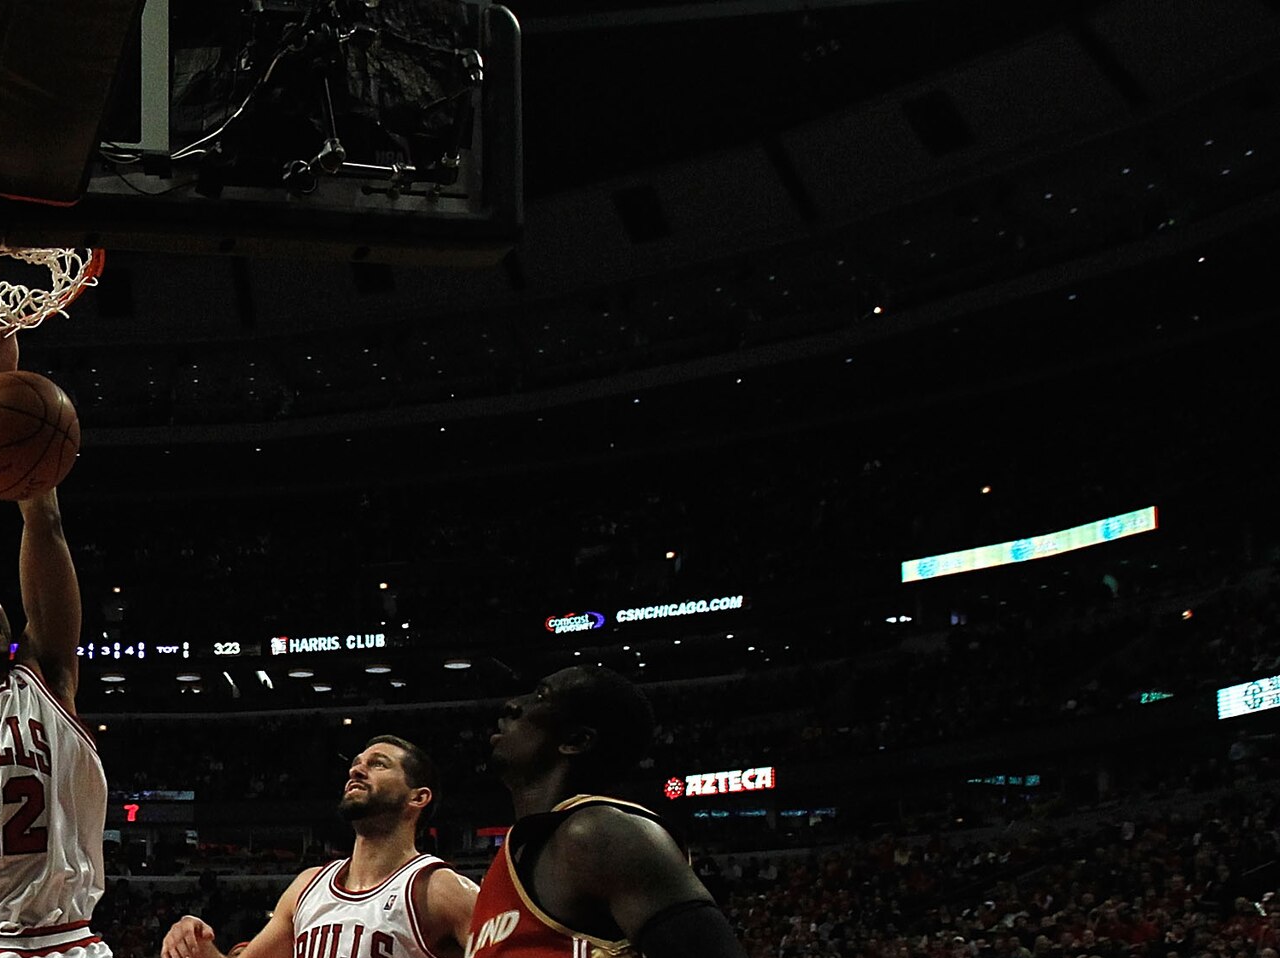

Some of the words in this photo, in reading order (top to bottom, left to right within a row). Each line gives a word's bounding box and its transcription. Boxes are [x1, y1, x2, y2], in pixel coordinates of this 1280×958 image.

[616, 595, 744, 623] CSNCHICAGO.COM
[548, 613, 590, 628] comcast
[345, 633, 387, 649] CLUB
[77, 646, 85, 655] 2
[101, 646, 111, 655] 3
[125, 646, 135, 655] 4
[214, 643, 241, 656] 3:23
[685, 766, 775, 797] AZTECA
